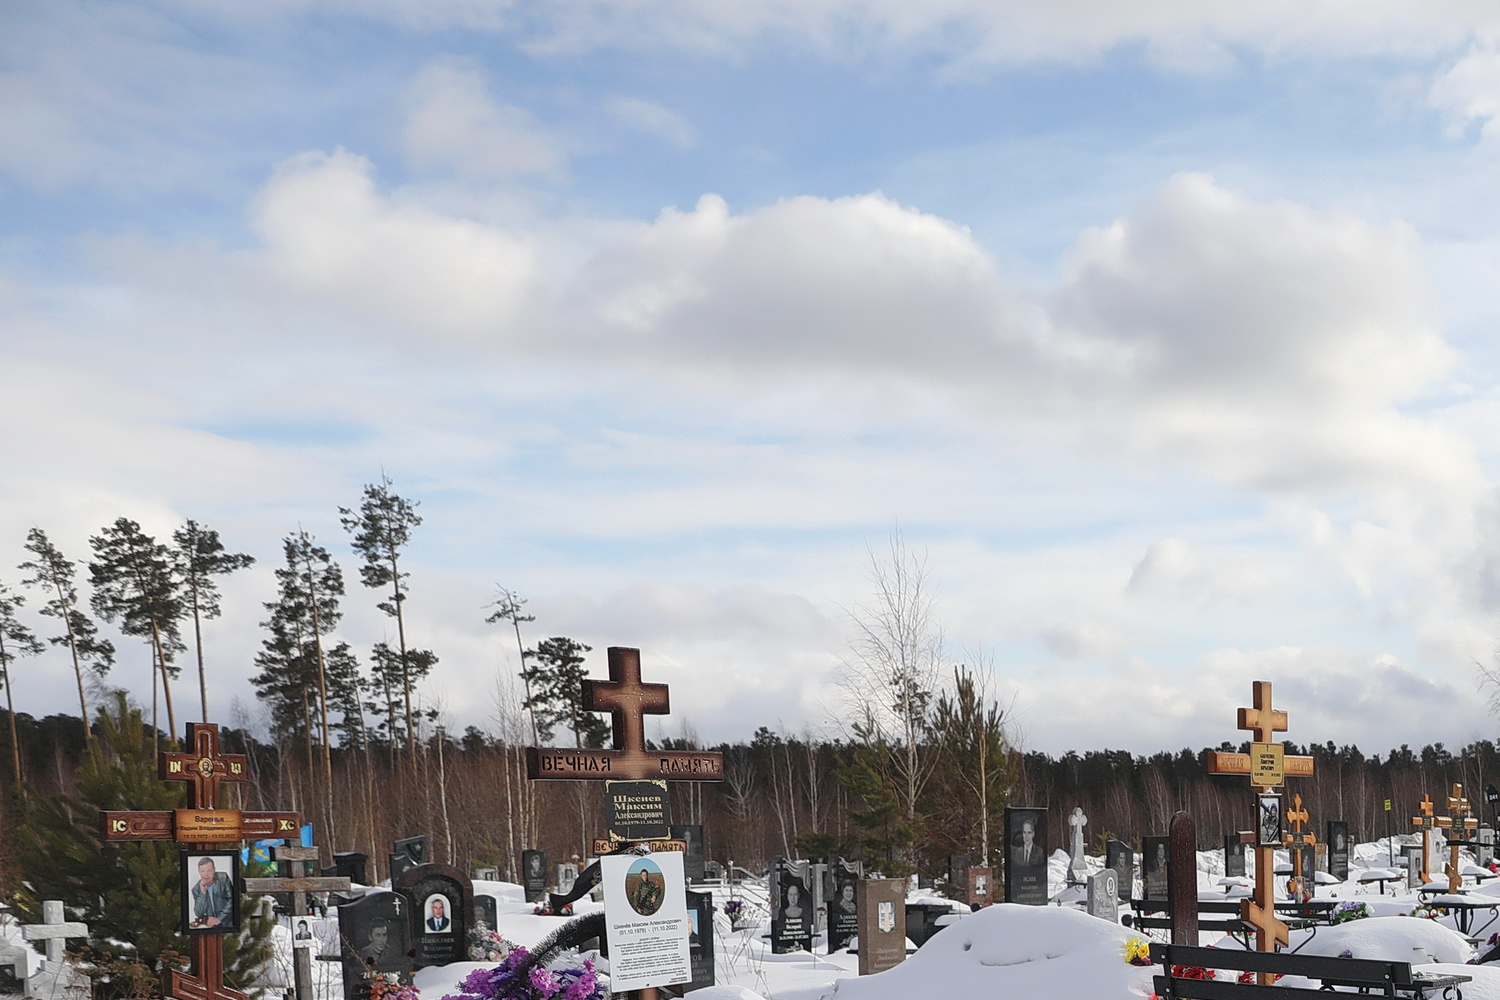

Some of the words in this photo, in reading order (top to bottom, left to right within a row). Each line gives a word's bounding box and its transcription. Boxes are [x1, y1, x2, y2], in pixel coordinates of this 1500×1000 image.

[541, 756, 611, 772] ВЕЧНАЯ
[659, 758, 721, 774] ПАМЯТЬ
[614, 802, 663, 810] Максим
[614, 812, 664, 820] Александрович
[649, 918, 683, 927] Александрович
